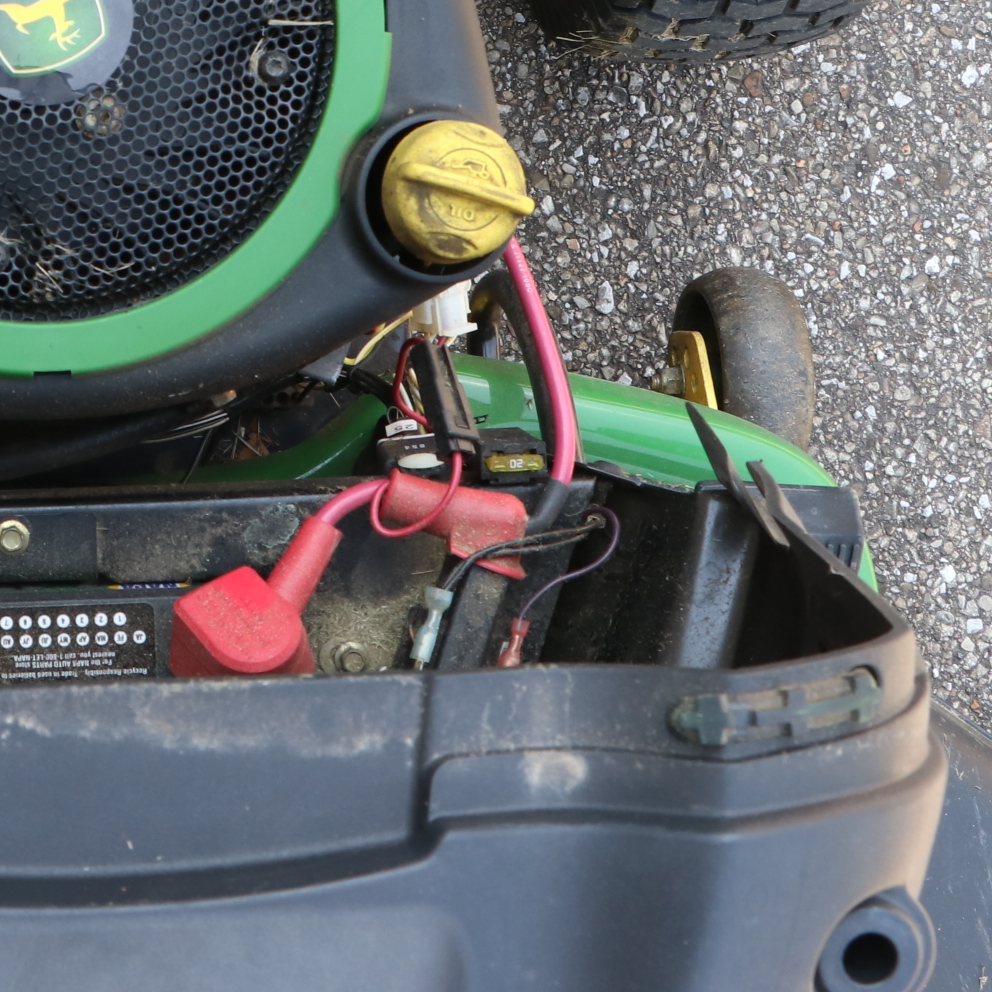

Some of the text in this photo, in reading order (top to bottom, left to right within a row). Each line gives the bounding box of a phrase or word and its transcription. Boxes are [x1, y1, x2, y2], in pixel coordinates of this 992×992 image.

[450, 204, 475, 221] OIL
[509, 458, 524, 469] 20
[92, 651, 115, 659] nearest
[123, 667, 147, 675] Recycle
